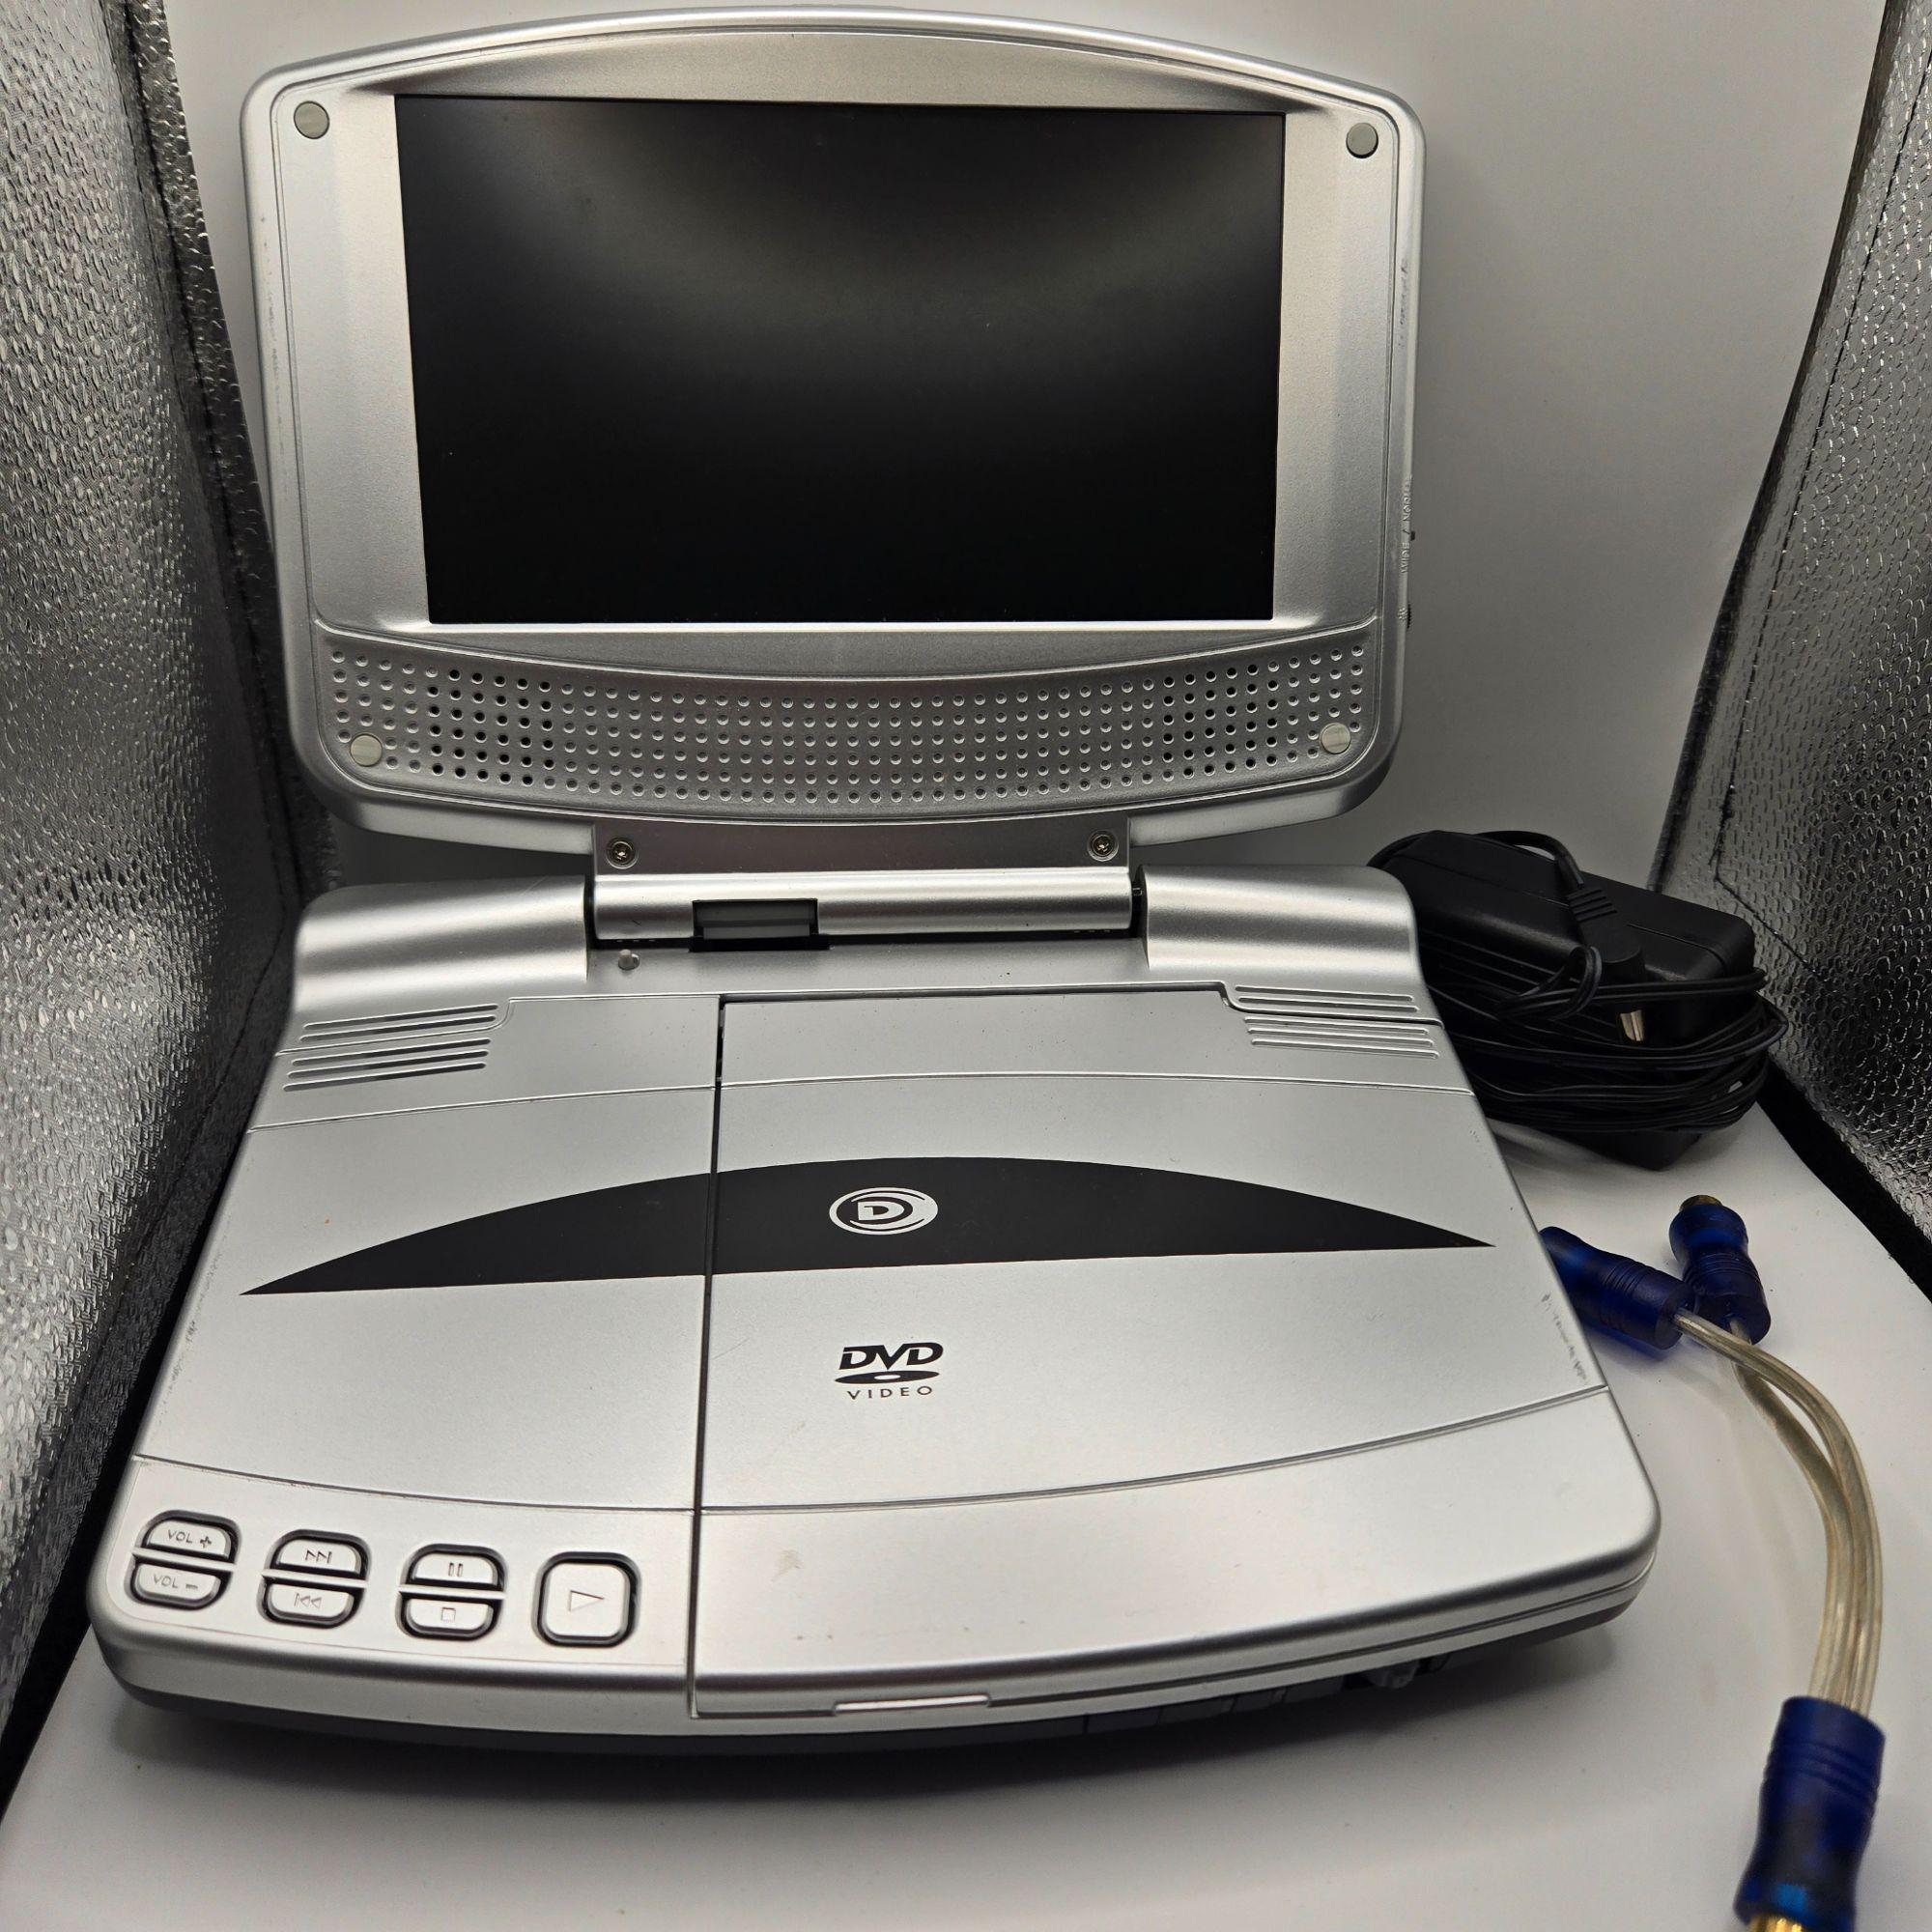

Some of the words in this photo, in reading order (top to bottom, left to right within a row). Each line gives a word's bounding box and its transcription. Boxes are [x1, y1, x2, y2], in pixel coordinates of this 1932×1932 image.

[838, 1342, 944, 1371] DVD
[846, 1385, 933, 1401] VIDEO
[167, 1529, 193, 1544] VOL
[153, 1574, 179, 1589] VOL
